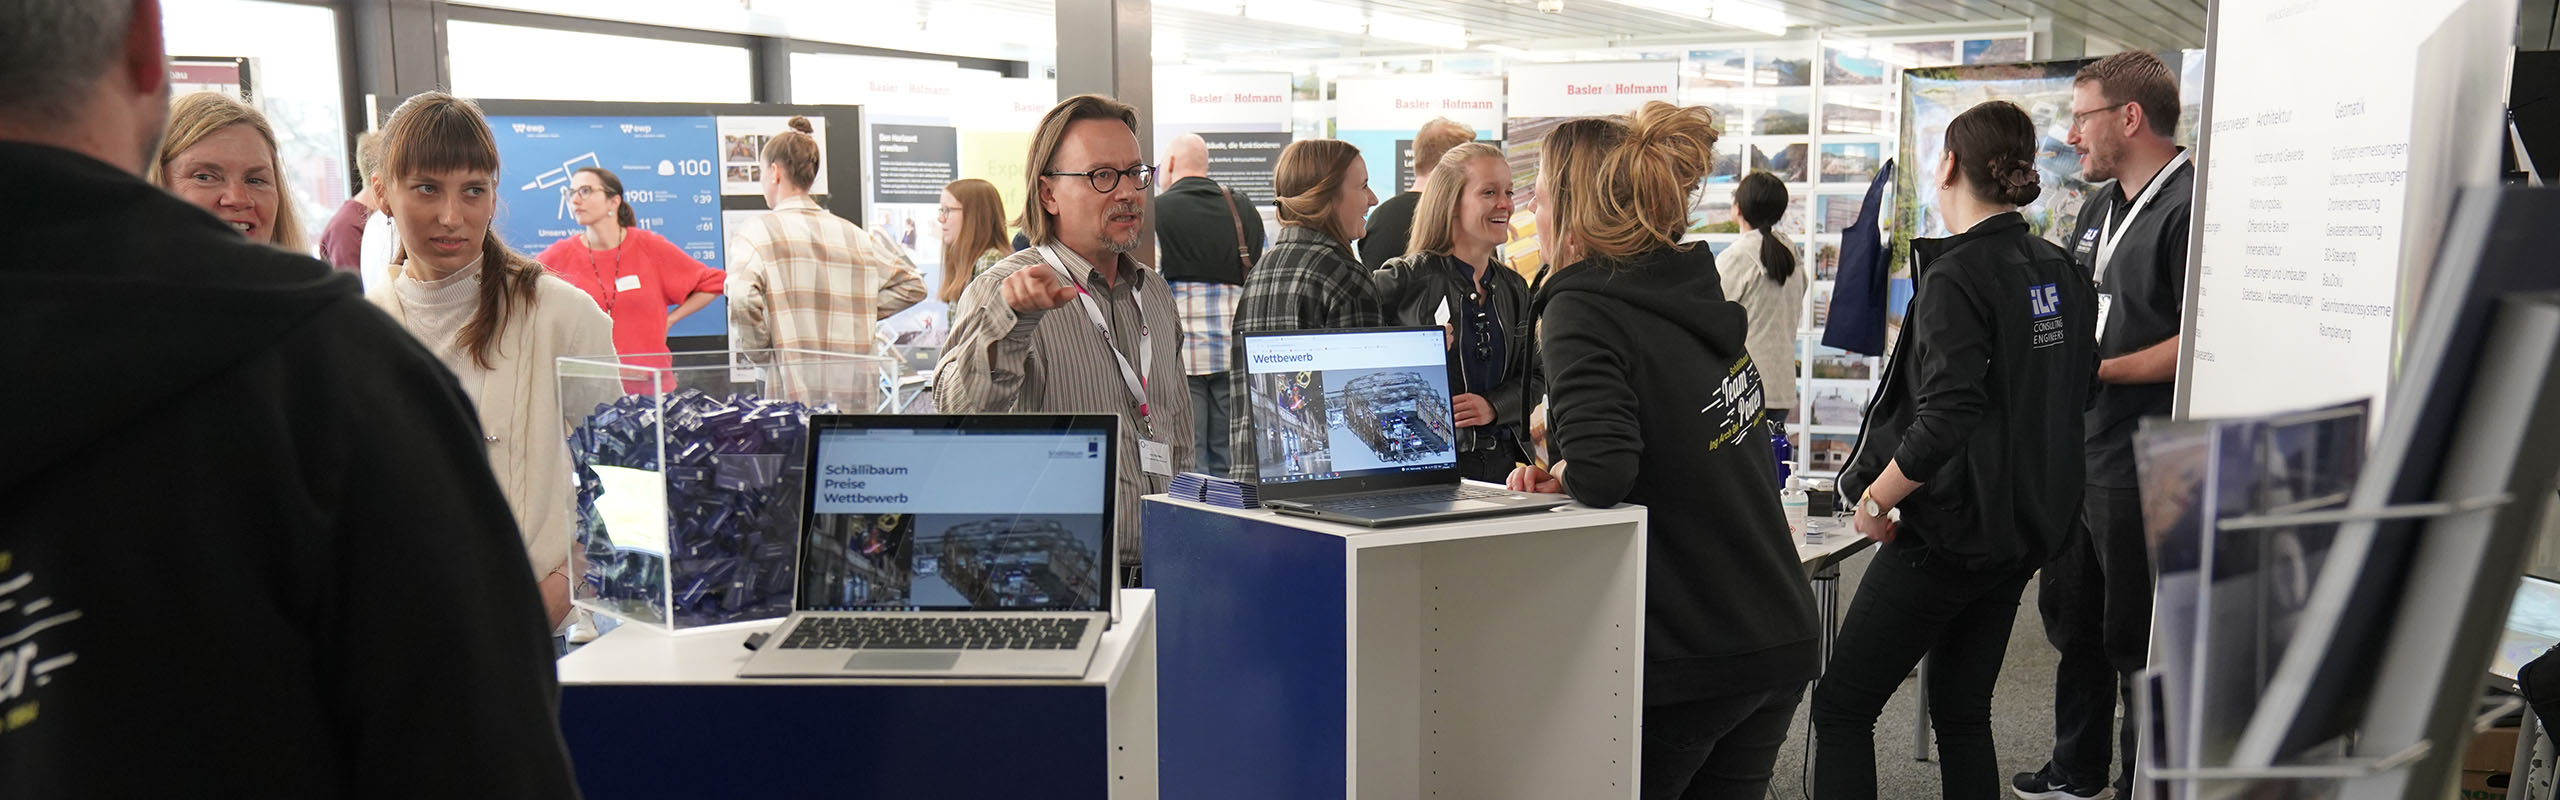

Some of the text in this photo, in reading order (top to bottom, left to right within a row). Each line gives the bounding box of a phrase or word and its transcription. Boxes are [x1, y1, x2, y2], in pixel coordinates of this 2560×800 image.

[1567, 84, 1603, 95] Basler
[1615, 83, 1668, 95] Hofmann
[1189, 93, 1282, 104] Basler Hofmann
[1395, 99, 1493, 109] Basler Hofmann
[677, 159, 711, 176] 100
[625, 189, 653, 203] 1901
[699, 194, 712, 204] 39
[639, 217, 651, 229] 11
[703, 221, 713, 231] 61
[538, 228, 567, 237] Unsere
[703, 250, 715, 260] 38
[2033, 319, 2063, 333] CONSULTING
[2033, 330, 2064, 345] ENGINEERS
[1253, 352, 1314, 364] Wettbewerb
[1721, 370, 1748, 408] Team
[825, 464, 908, 476] Schällibaum
[825, 478, 866, 490] Preise
[824, 493, 908, 504] Wettbewerb
